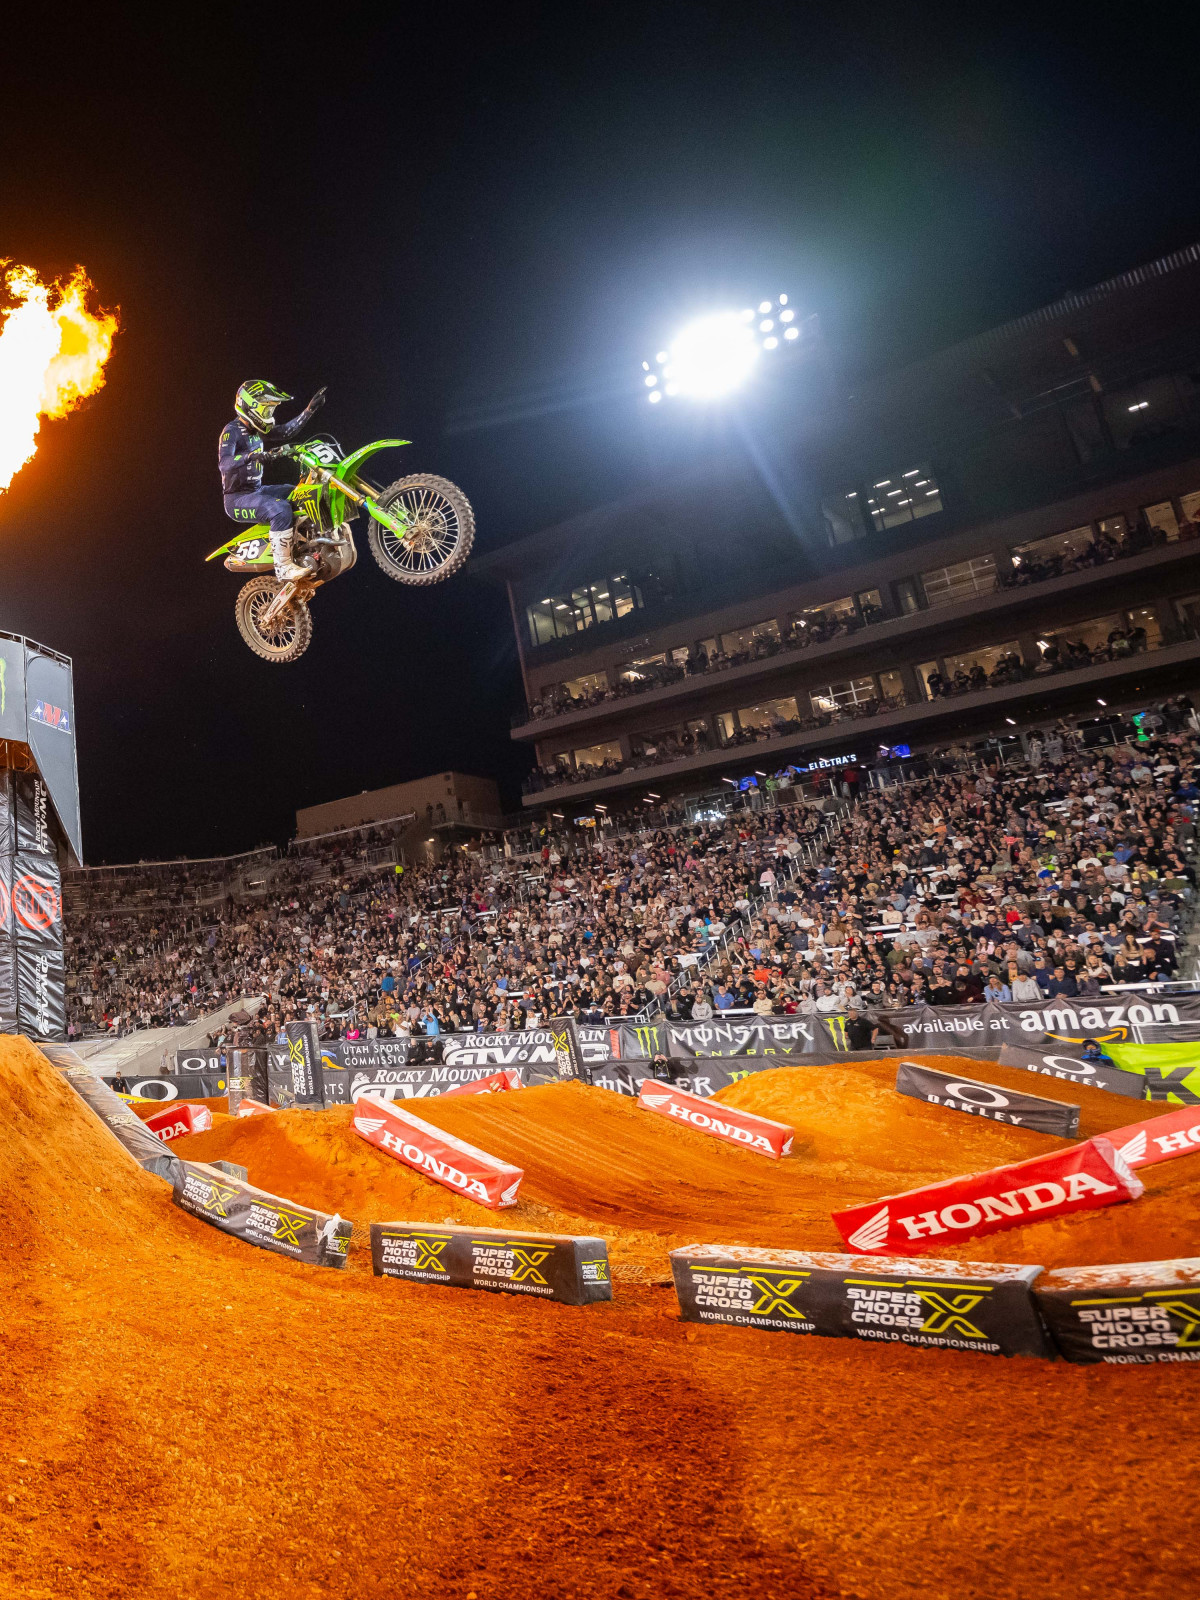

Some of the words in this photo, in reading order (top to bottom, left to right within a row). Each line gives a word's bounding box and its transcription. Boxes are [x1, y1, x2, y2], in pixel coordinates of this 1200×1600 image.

[234, 509, 256, 519] FOX
[236, 540, 260, 560] 56
[29, 699, 71, 731] AMA
[808, 754, 857, 771] ELECTRA'S
[903, 1016, 985, 1035] available
[990, 1016, 1011, 1031] at
[1019, 1002, 1180, 1032] amazon
[464, 1034, 517, 1048] ROCKY
[671, 1022, 814, 1047] MONSTER
[343, 1045, 369, 1055] UTAH
[345, 1055, 406, 1066] COMMISSIO
[373, 1069, 428, 1084] ROCKY
[1027, 1064, 1110, 1088] OAKLEY
[927, 1094, 1023, 1126] OAKLEY
[667, 1102, 776, 1153] HONDA
[380, 1130, 492, 1203] HONDA
[184, 1176, 212, 1192] SUPER
[185, 1184, 209, 1199] MOTO
[182, 1190, 208, 1206] CROSS
[896, 1171, 1118, 1240] HONDA
[180, 1198, 196, 1210] WORLD
[195, 1206, 229, 1225] CHAMPIONSHIP
[249, 1212, 278, 1227] MOTO
[250, 1204, 280, 1221] SUPER
[245, 1218, 277, 1234] CROSS
[245, 1228, 263, 1240] WORLD
[263, 1236, 302, 1254] CHAMPIONSHIP
[381, 1239, 417, 1250] SUPER
[381, 1255, 417, 1266] CROSS
[383, 1247, 416, 1258] MOTO
[472, 1247, 515, 1260] SUPER
[474, 1257, 514, 1268] MOTO
[383, 1268, 404, 1276] WORLD
[404, 1270, 450, 1281] CHAMPIONSHIP
[472, 1265, 515, 1278] CROSS
[473, 1279, 498, 1288] WORLD
[498, 1281, 554, 1295] CHAMPIONSHIP
[692, 1273, 753, 1289] SUPER
[697, 1285, 752, 1300] MOTO
[846, 1288, 922, 1305] SUPER
[694, 1295, 754, 1310] CROSS
[853, 1300, 921, 1317] MOTO
[699, 1310, 734, 1323] WORLD
[735, 1315, 816, 1331] CHAMPIONSHIP
[851, 1311, 925, 1328] CROSS
[1077, 1306, 1169, 1323] SUPER
[1091, 1319, 1171, 1335] MOTO
[857, 1328, 900, 1342] WORLD
[901, 1333, 1000, 1352] CHAMPIONSHIP
[1091, 1332, 1180, 1348] CROSS
[1103, 1353, 1156, 1365] WORLD
